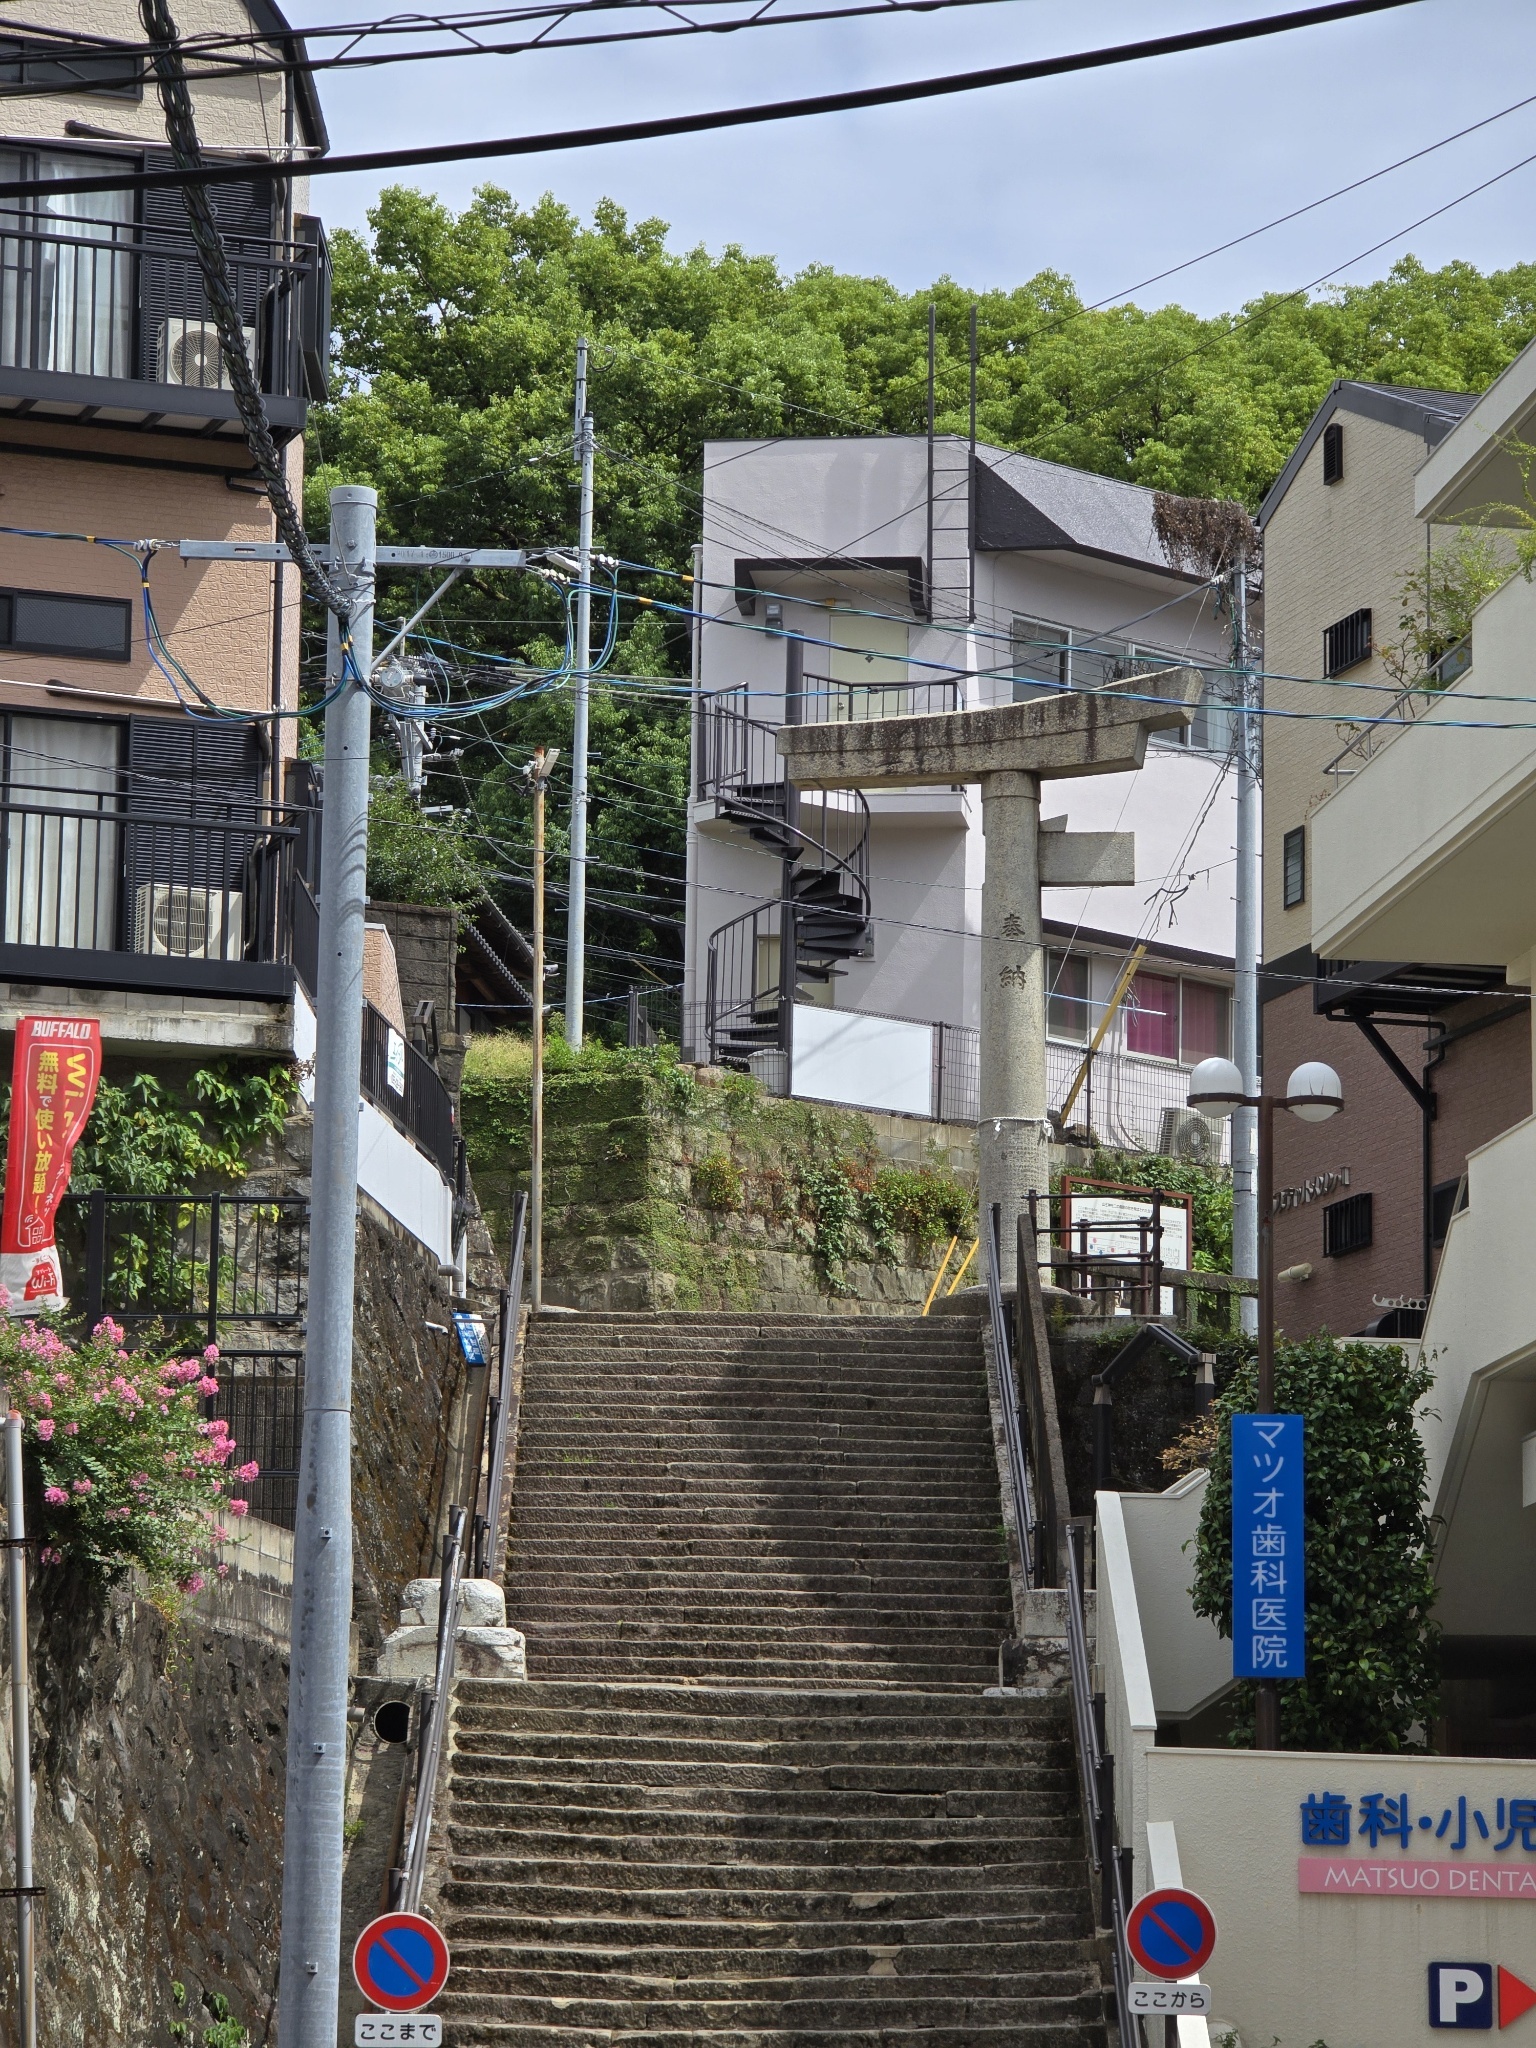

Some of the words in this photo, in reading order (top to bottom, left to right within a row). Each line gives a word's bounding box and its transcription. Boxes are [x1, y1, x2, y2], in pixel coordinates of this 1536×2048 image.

[998, 913, 1027, 990] 奉納
[31, 1020, 91, 1039] BUFFALO
[31, 1273, 56, 1289] Wi-Fi
[1250, 1421, 1287, 1669] マツオ歯科医院
[1325, 1866, 1440, 1890] MATSUO
[1134, 1990, 1205, 2008] ここから
[1439, 1968, 1484, 2023] P
[360, 2023, 437, 2041] ここまで
